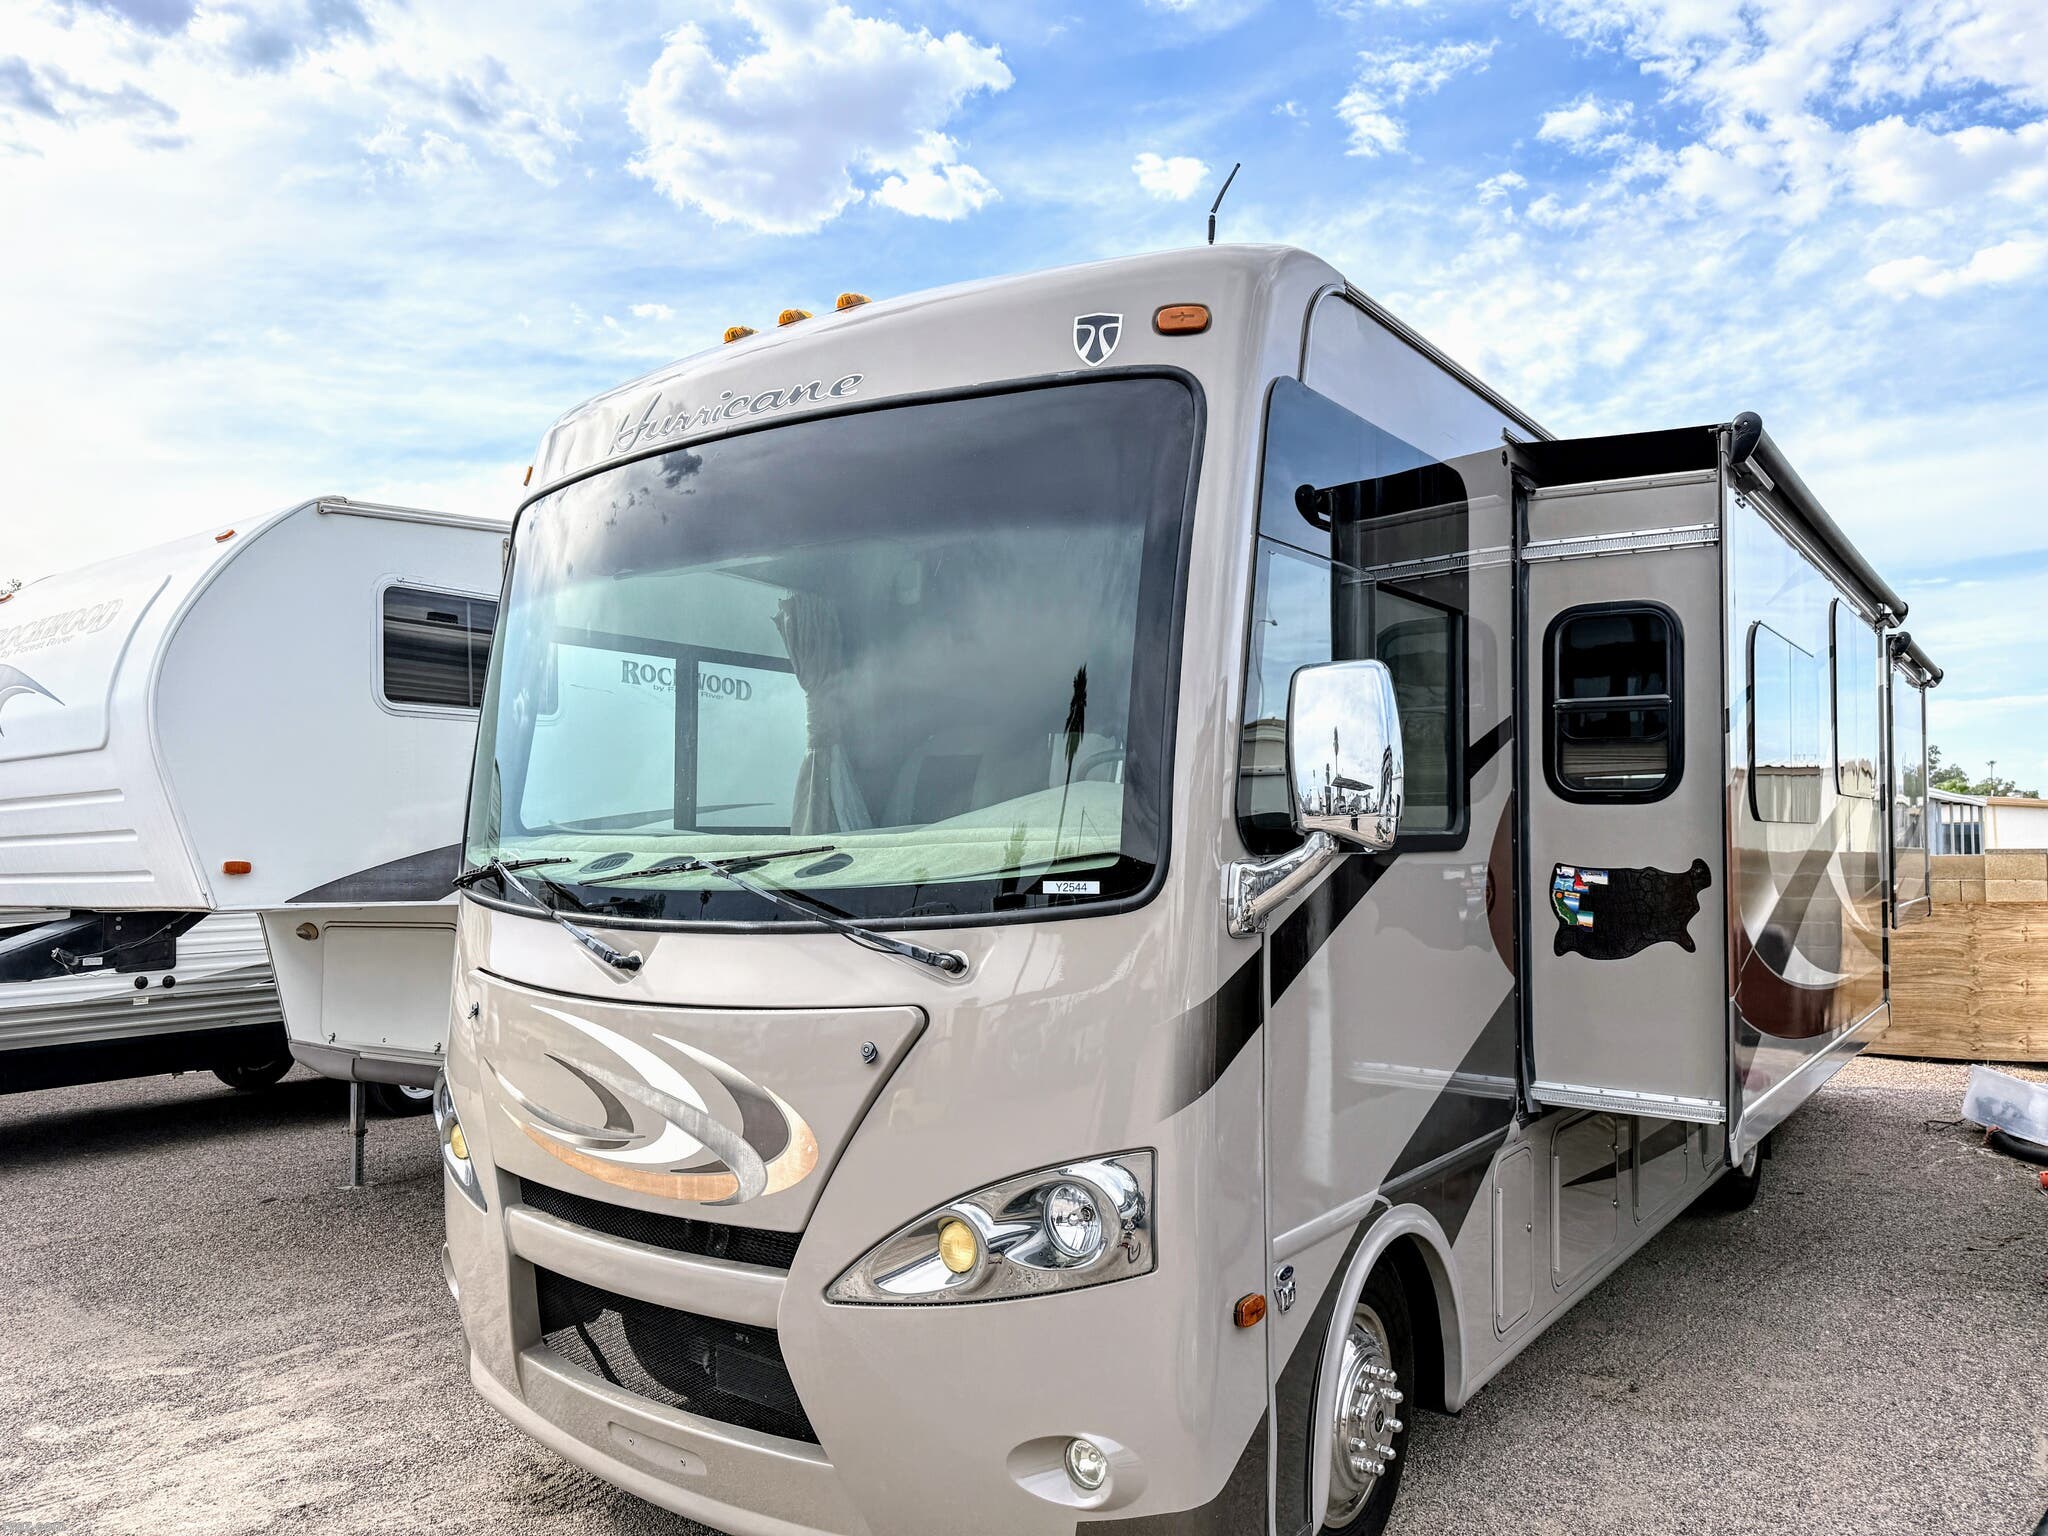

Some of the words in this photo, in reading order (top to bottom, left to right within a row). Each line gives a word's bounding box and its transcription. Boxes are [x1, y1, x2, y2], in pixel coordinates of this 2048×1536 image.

[608, 373, 865, 456] Hurricane
[621, 660, 752, 701] ROCOOD
[1056, 882, 1087, 892] Y2544
